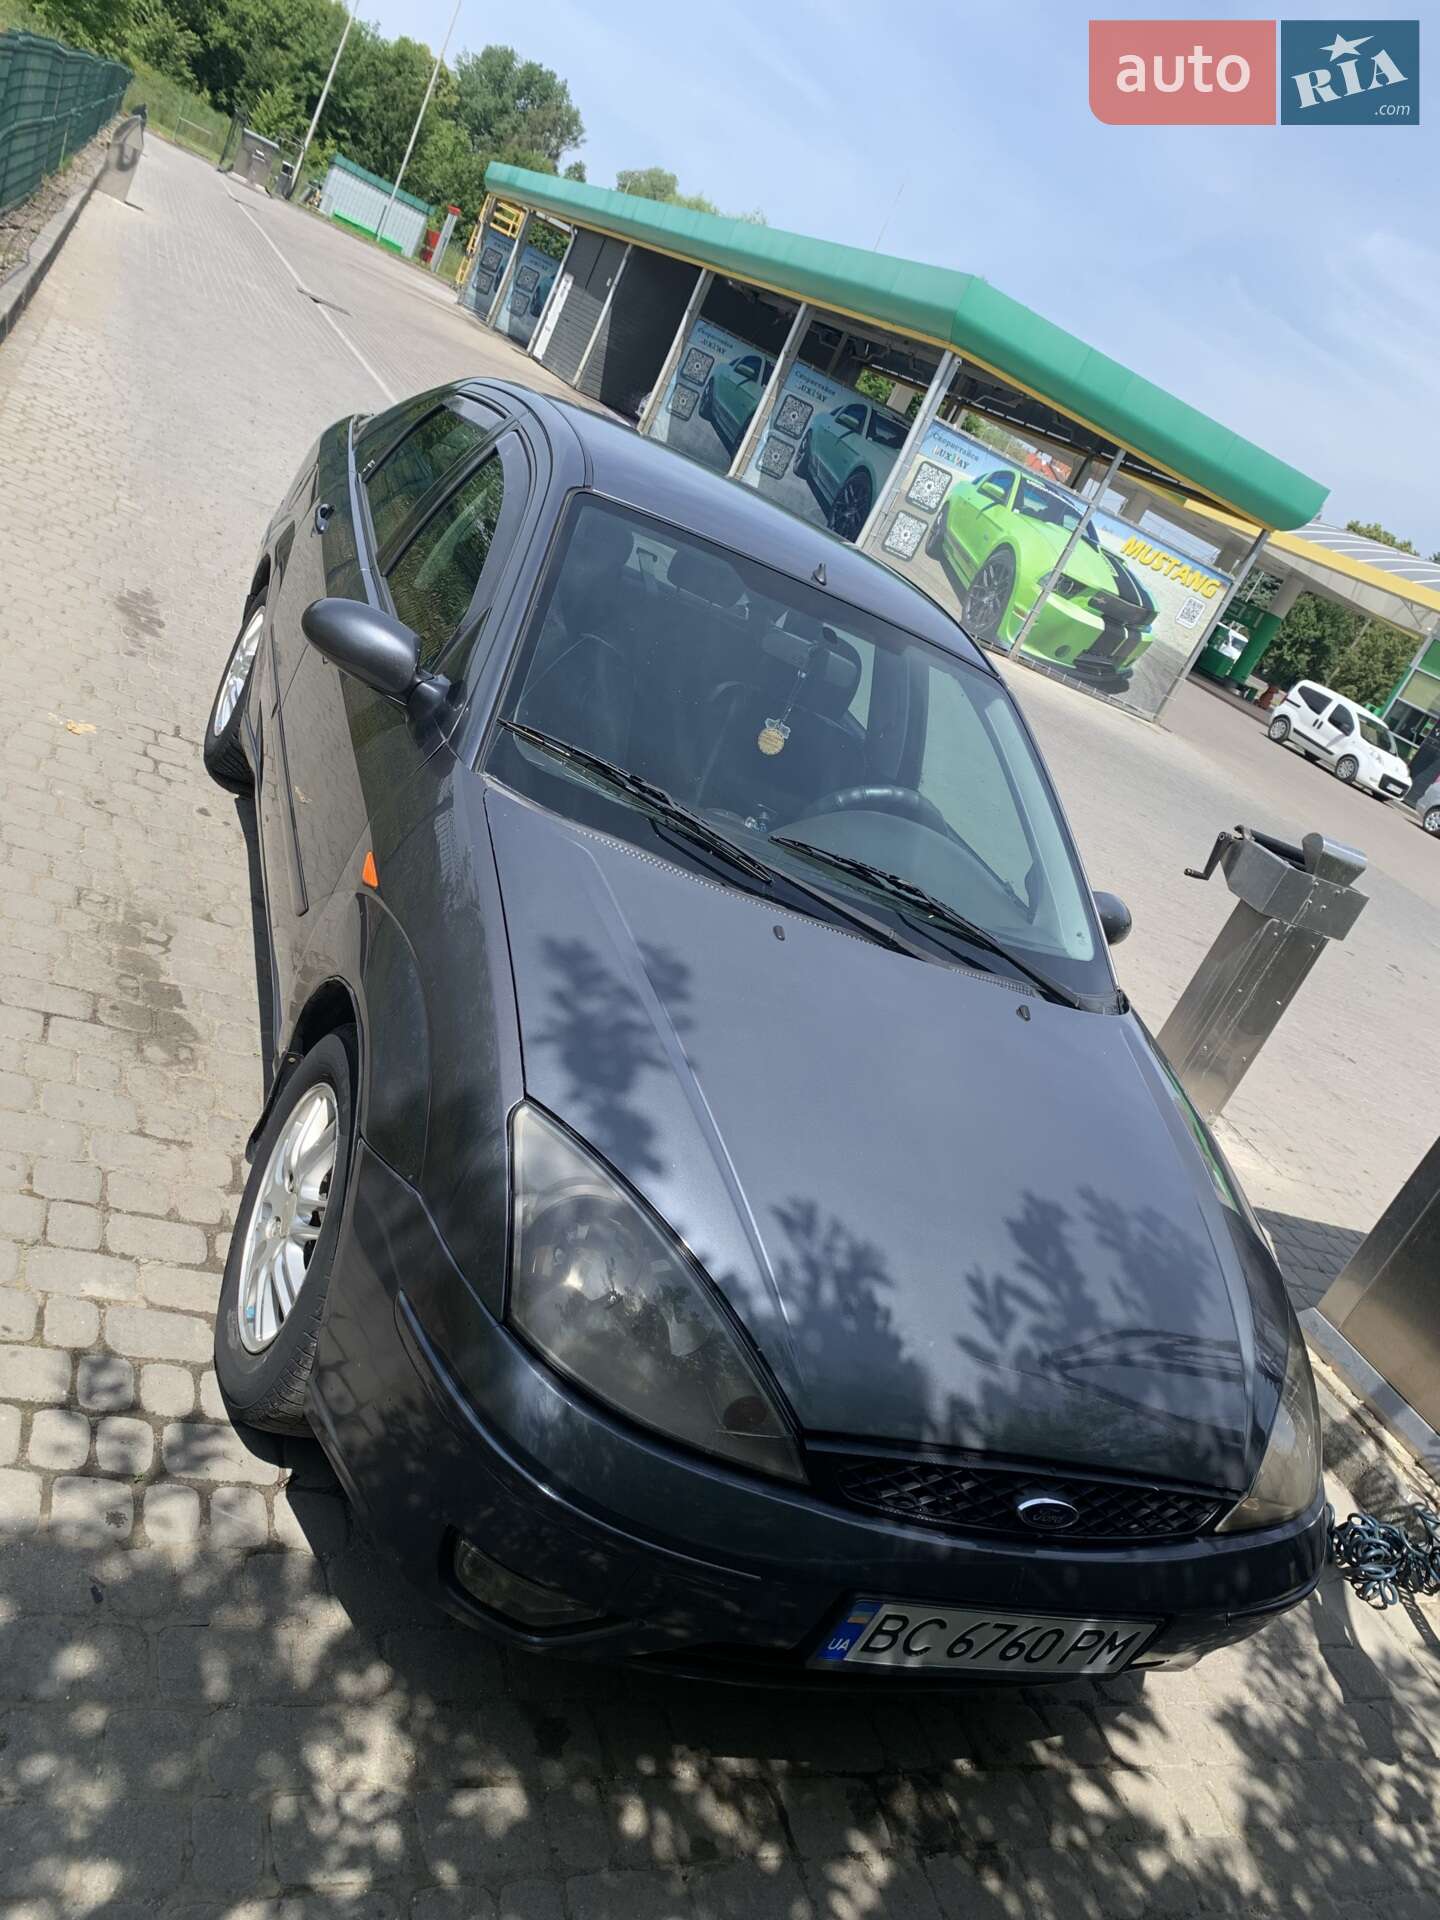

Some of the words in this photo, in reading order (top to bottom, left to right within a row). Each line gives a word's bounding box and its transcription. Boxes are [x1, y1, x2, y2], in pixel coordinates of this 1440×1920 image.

[1121, 535, 1221, 599] MUSTANG
[827, 1637, 851, 1651] UA
[860, 1613, 948, 1657] BC
[946, 1621, 1065, 1663] 6760
[1056, 1629, 1142, 1665] PM
